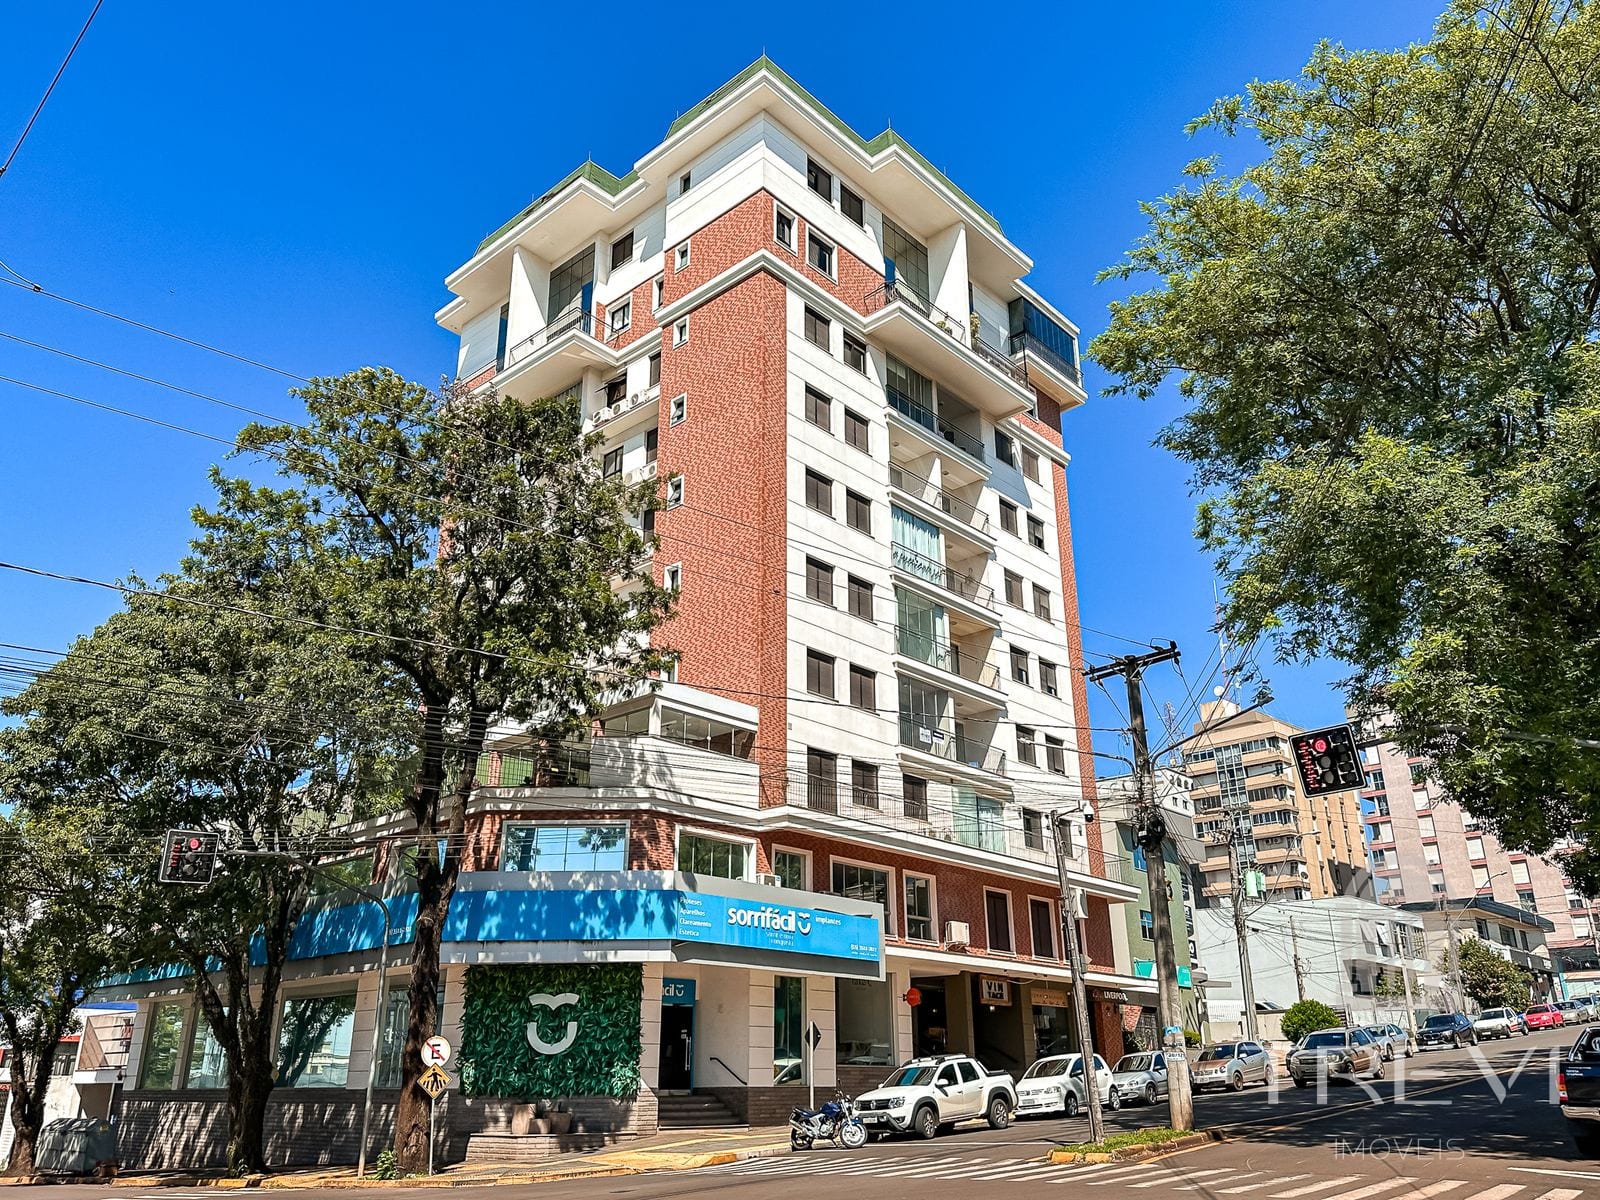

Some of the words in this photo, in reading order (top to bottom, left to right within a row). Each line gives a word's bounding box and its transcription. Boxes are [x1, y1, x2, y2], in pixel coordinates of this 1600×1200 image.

[727, 906, 796, 933] sorrifácil
[986, 981, 1004, 992] VIN
[431, 1043, 442, 1060] E
